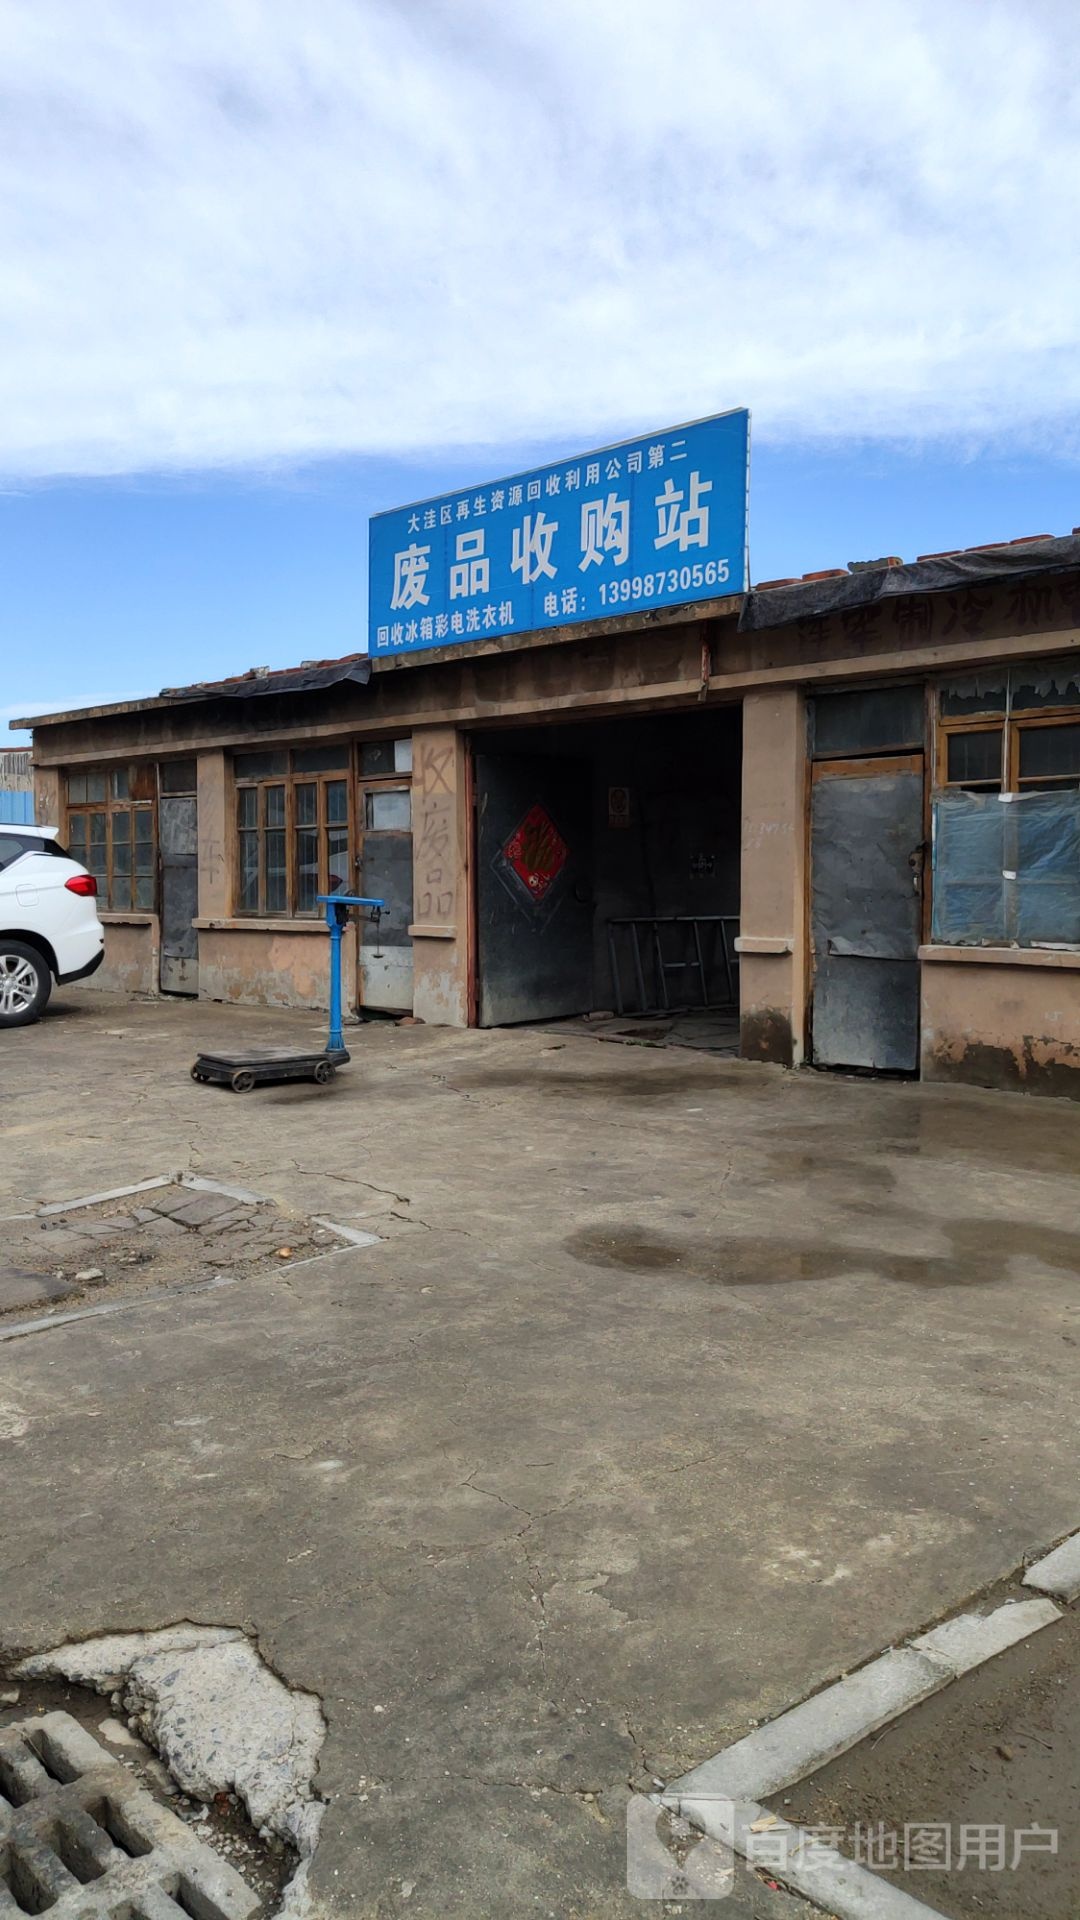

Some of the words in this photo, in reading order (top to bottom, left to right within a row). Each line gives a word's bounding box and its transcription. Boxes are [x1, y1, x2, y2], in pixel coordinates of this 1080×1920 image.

[407, 439, 688, 534] 大洼区再生资源回收利用公司第二
[389, 471, 713, 611] 废品收购站
[598, 558, 730, 606] 13998730565
[376, 600, 515, 648] 回收冰箱彩电洗衣机
